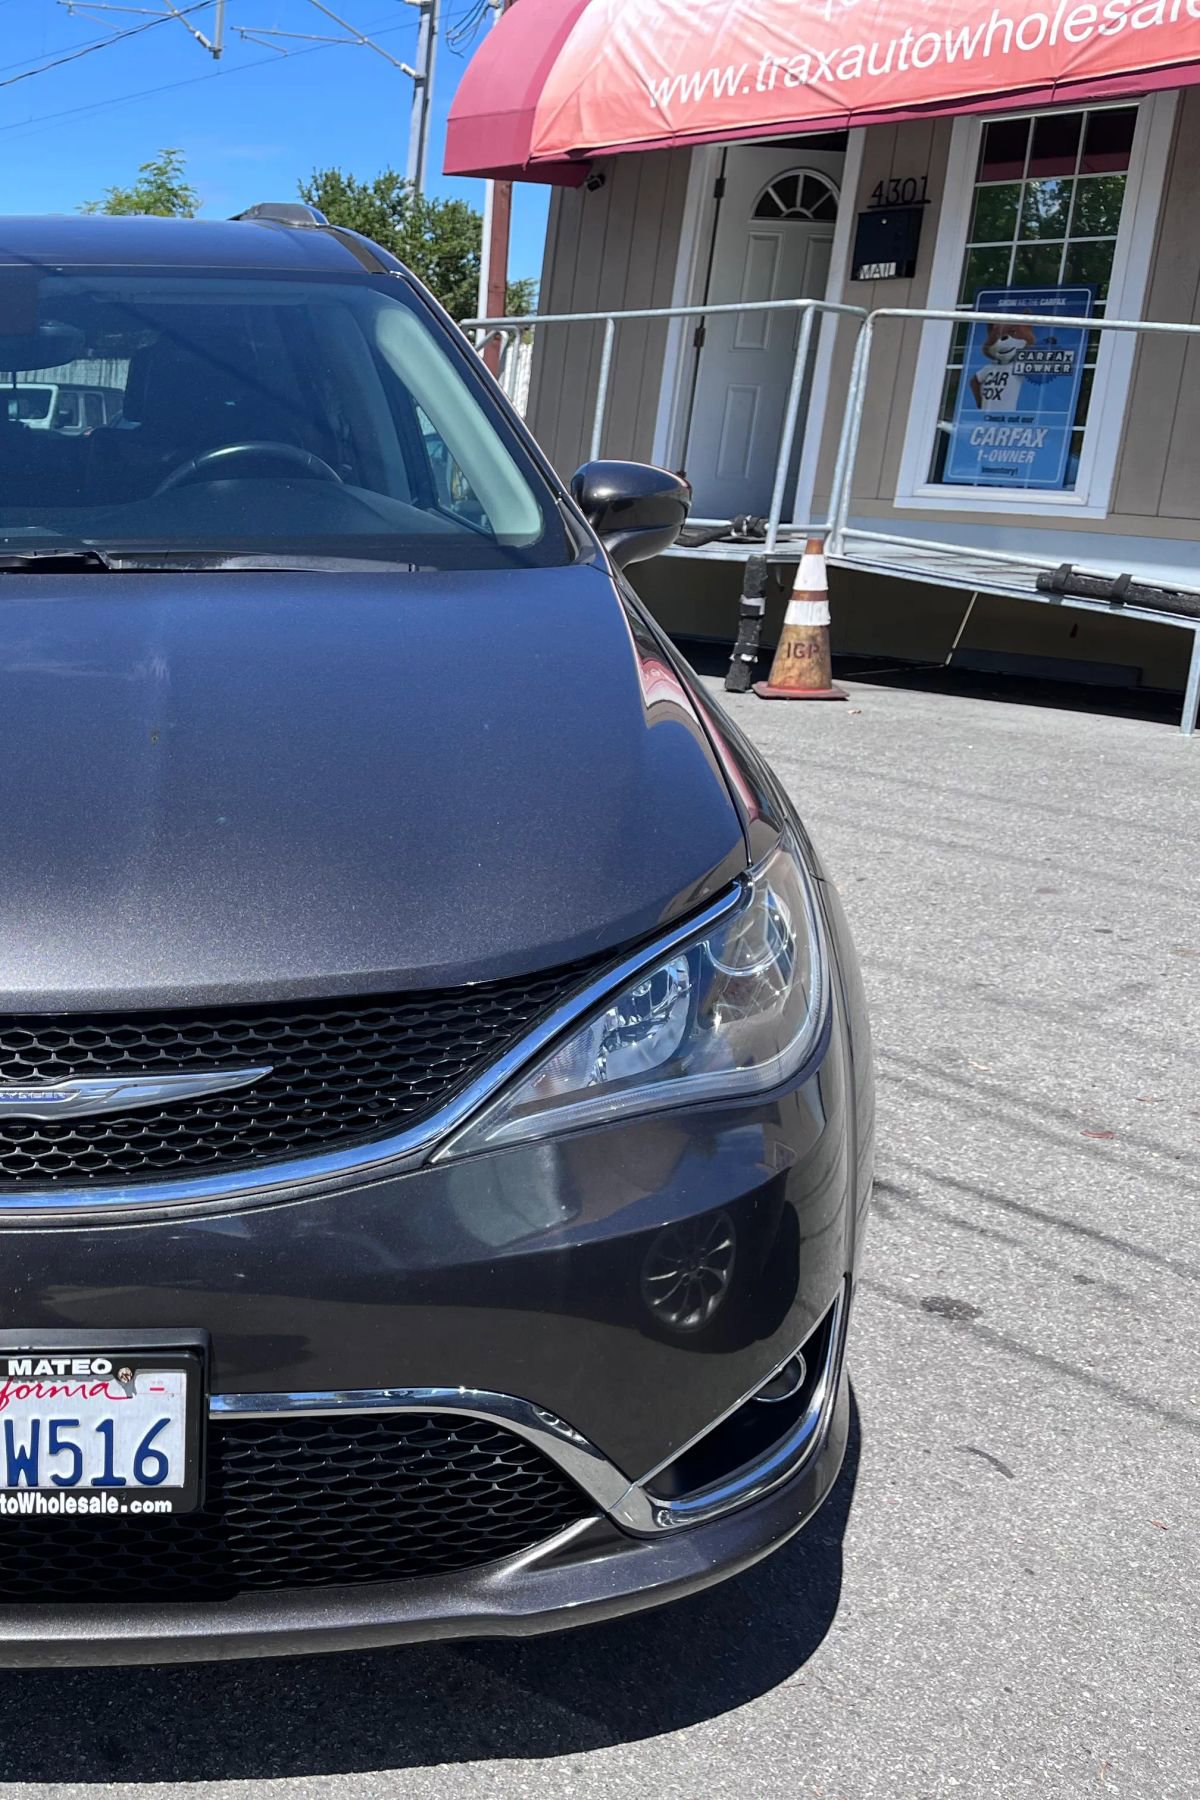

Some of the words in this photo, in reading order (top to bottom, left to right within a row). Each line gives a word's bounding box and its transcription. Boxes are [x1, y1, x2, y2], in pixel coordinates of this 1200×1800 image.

[871, 176, 928, 204] 4301
[858, 262, 896, 279] MAIL
[1018, 352, 1073, 362] CARFAX
[984, 371, 1009, 386] CAR
[970, 426, 1048, 448] CARFAX
[977, 449, 1036, 463] 1-OWNER
[8, 1358, 113, 1376] MATEO
